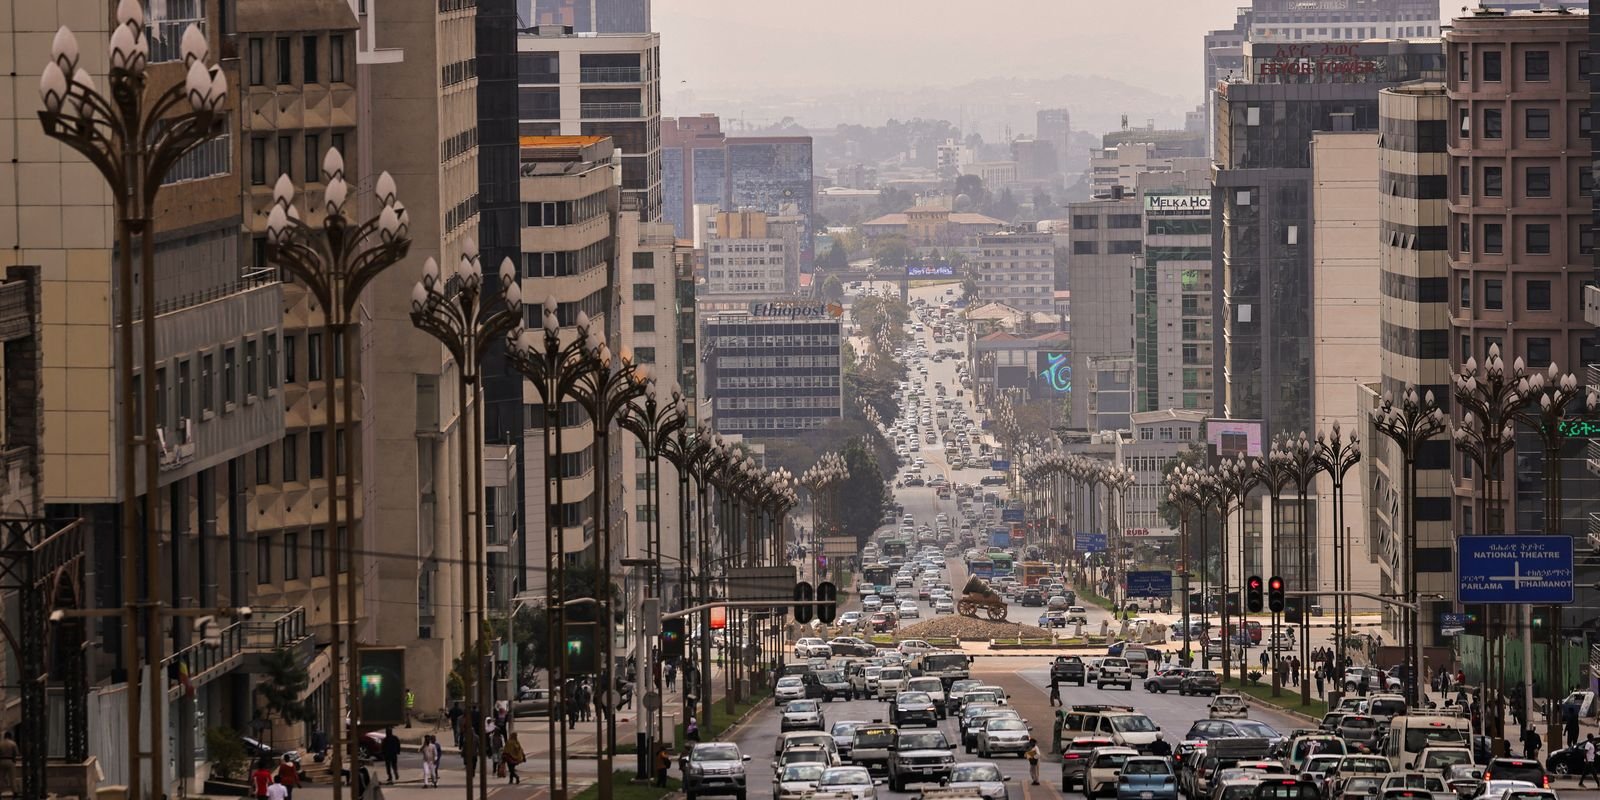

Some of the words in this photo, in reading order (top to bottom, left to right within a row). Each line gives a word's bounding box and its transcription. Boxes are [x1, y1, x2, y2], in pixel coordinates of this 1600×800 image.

[1150, 196, 1187, 207] MELKA
[753, 302, 826, 320] Ethiopost
[1126, 527, 1150, 536] RUBIS
[1473, 551, 1518, 559] NATIONAL
[1520, 551, 1560, 559] THEATRE
[1460, 582, 1503, 590] PARLAMA
